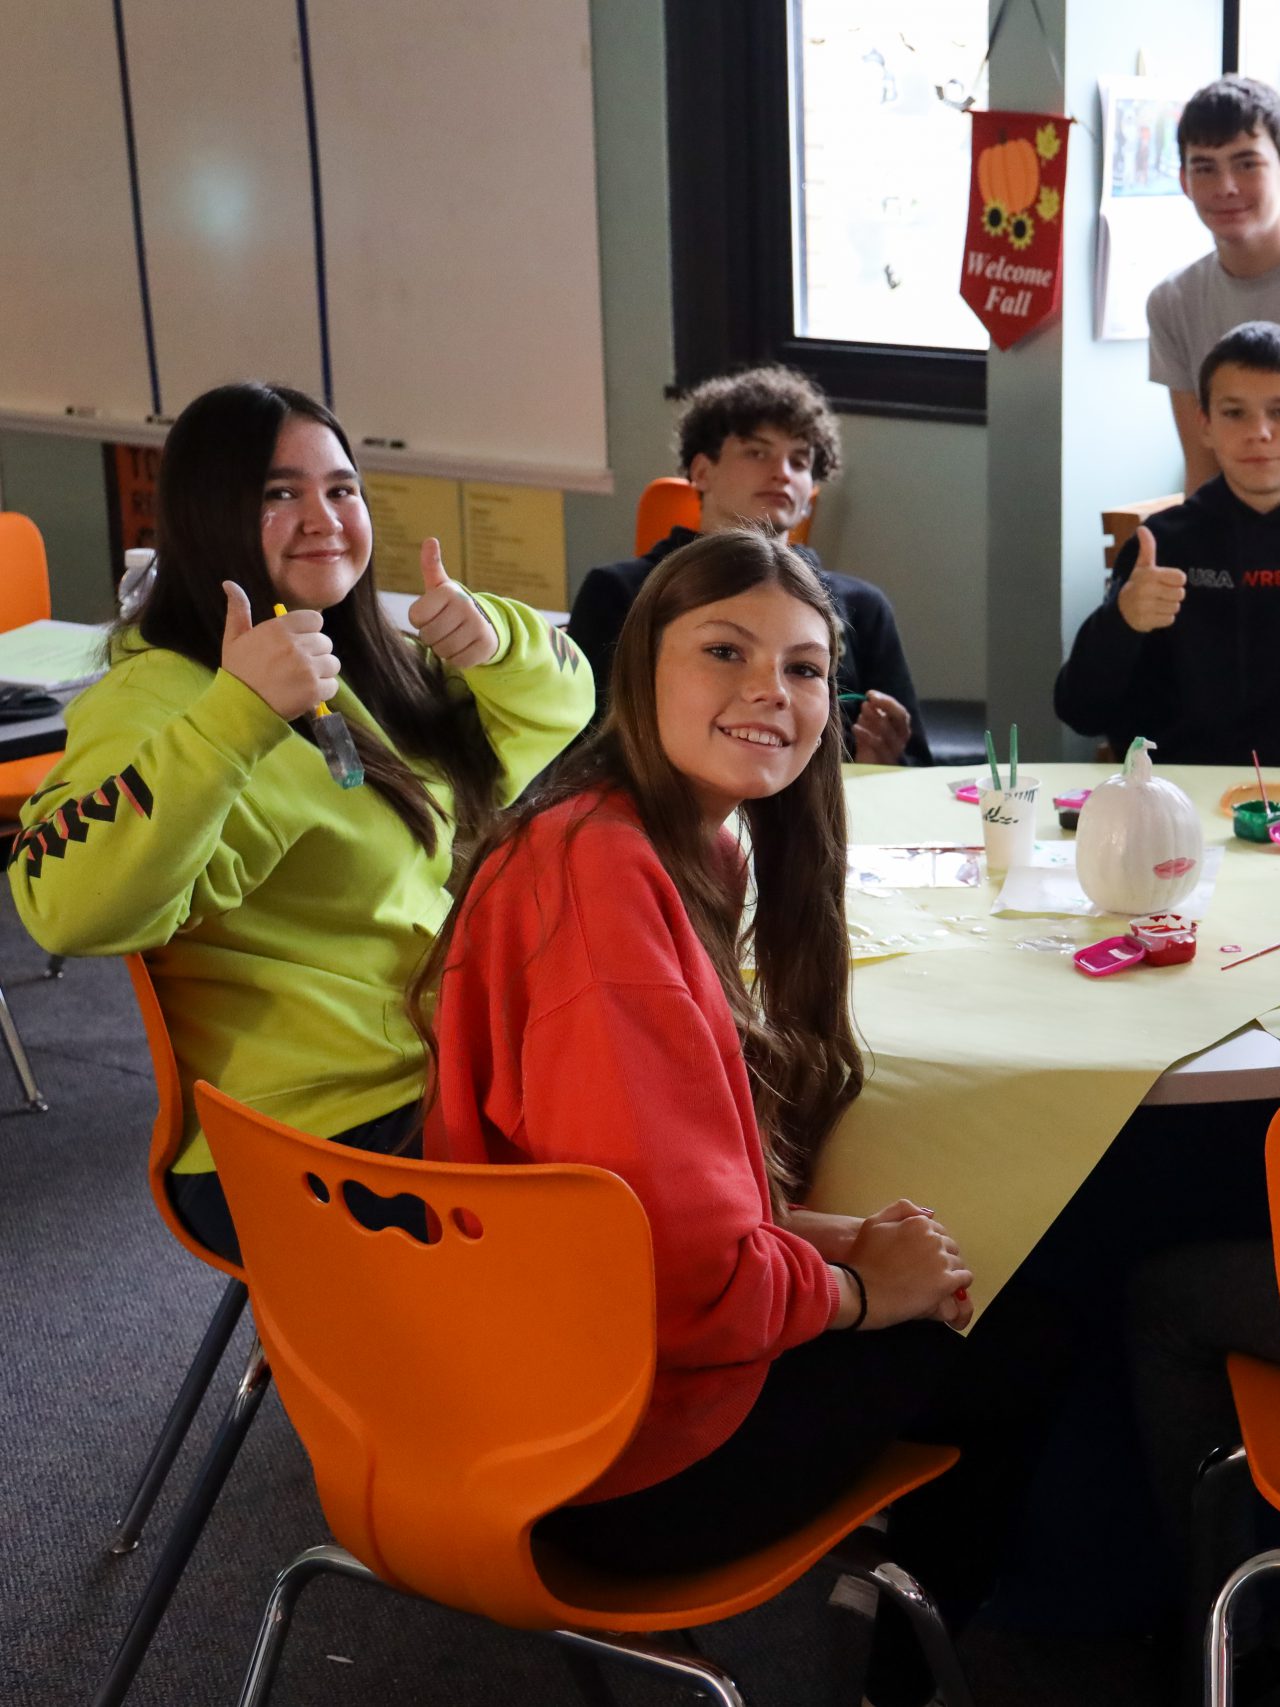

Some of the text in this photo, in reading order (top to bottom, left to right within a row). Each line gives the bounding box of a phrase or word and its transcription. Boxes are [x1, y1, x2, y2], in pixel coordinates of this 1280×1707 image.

[967, 251, 1053, 287] Welcome
[984, 285, 1032, 317] Fall
[1188, 567, 1234, 588] USA
